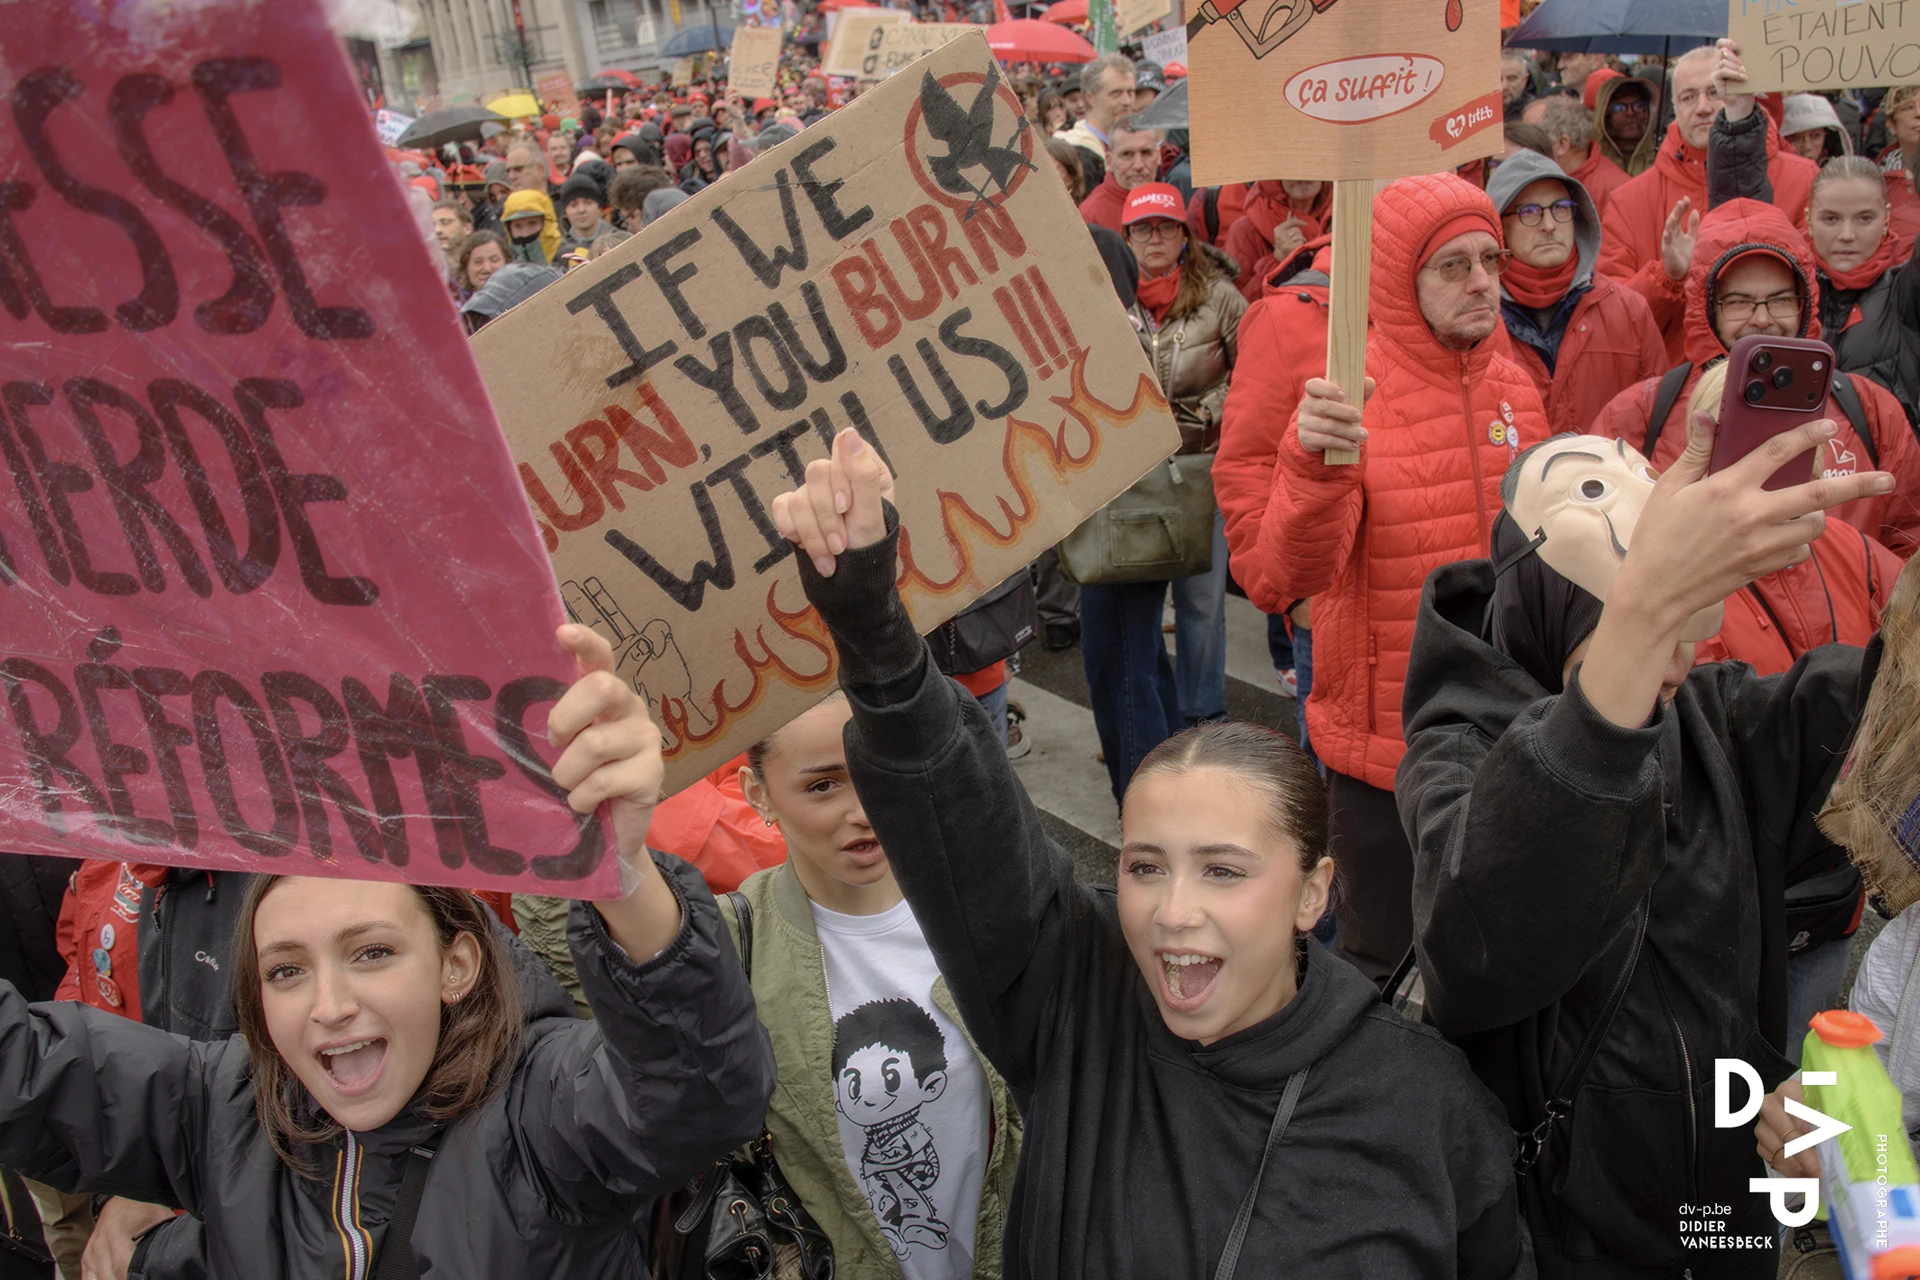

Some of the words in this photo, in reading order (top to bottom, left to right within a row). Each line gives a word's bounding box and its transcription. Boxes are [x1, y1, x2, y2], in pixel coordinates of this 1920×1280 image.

[0, 56, 376, 341] ESSE
[1335, 67, 1418, 102] suffit
[515, 380, 712, 554] URN,
[673, 280, 849, 435] YOU
[829, 203, 1027, 352] BURN
[565, 226, 708, 390] IF
[711, 135, 875, 289] WE
[0, 626, 603, 881] RÉFORMES
